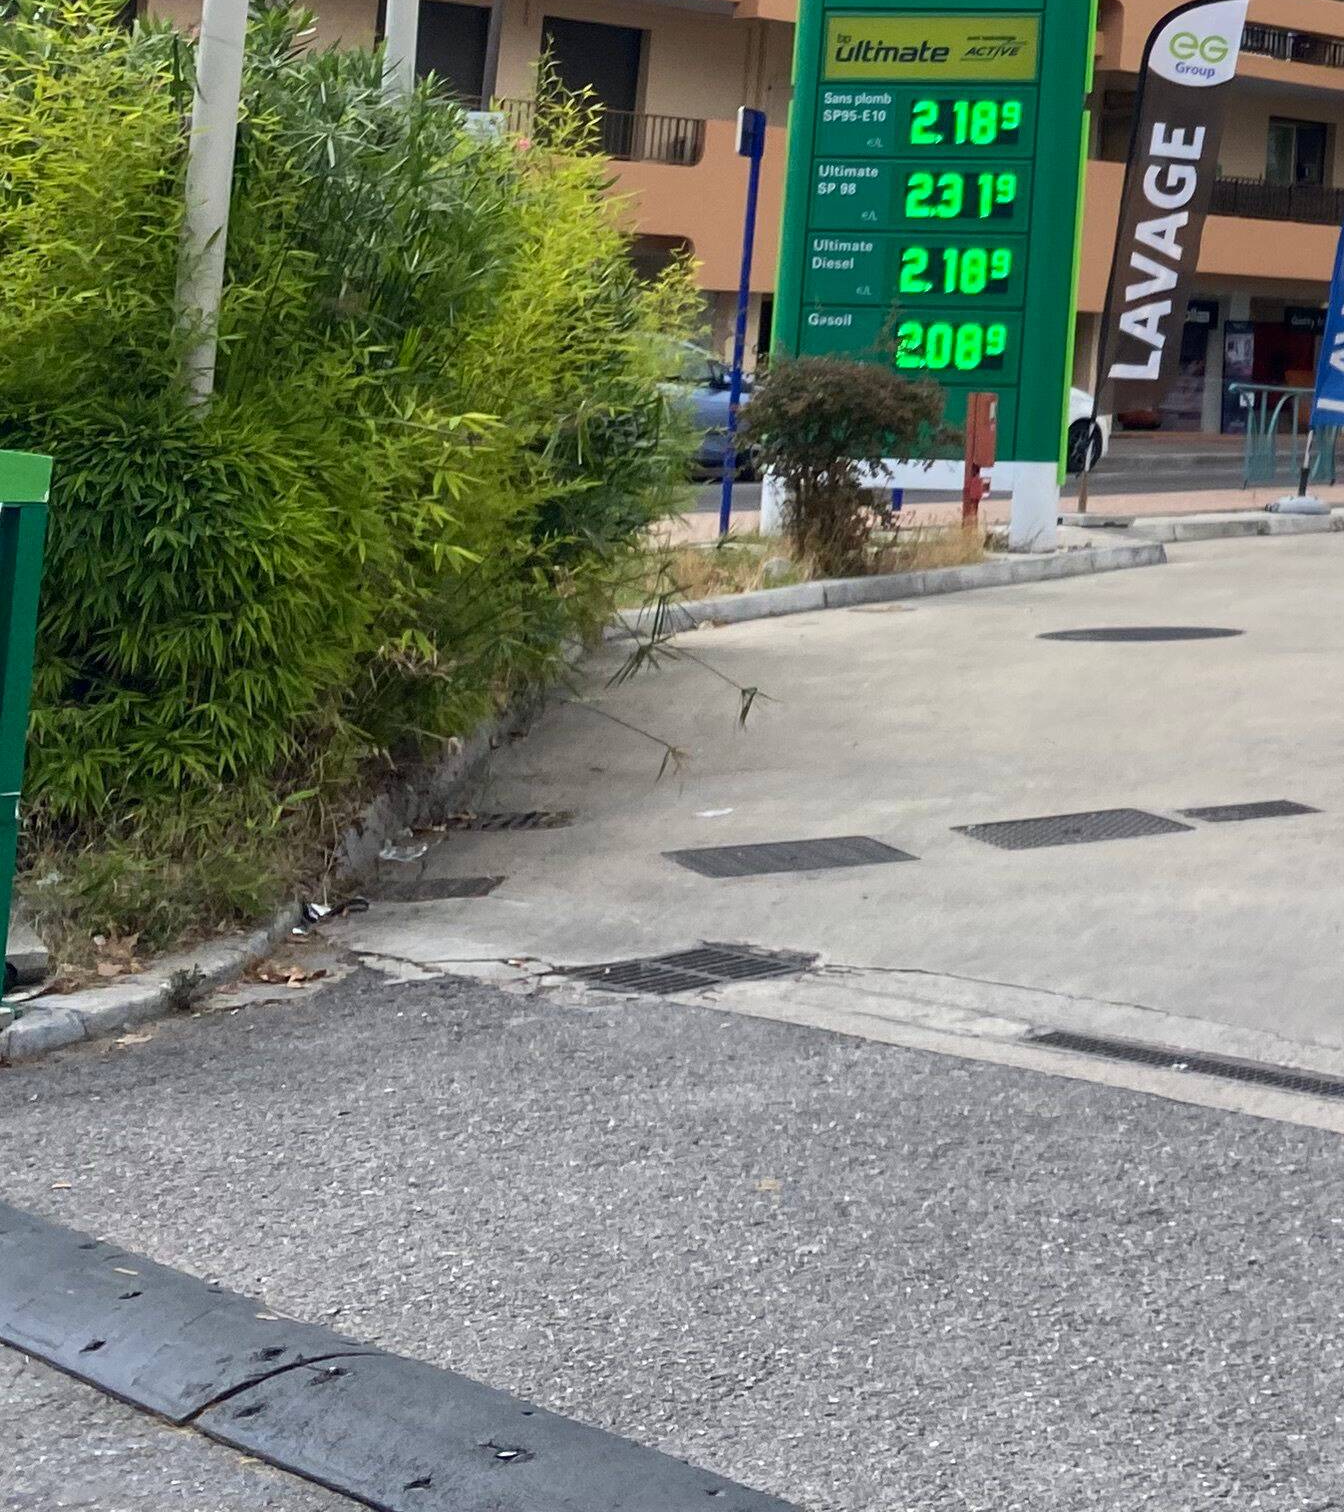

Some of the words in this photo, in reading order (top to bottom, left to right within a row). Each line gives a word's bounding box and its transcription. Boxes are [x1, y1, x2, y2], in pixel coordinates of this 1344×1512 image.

[835, 39, 950, 63] ultimate
[964, 45, 1020, 57] ACTIVE
[1175, 61, 1215, 79] Group
[824, 92, 852, 104] Sans
[853, 92, 892, 107] plomb
[823, 109, 886, 123] SP95-E10
[818, 165, 879, 178] Ultimate
[817, 182, 836, 196] SP
[813, 240, 873, 253] Ultimate
[1108, 121, 1206, 381] LAVAGE
[811, 257, 854, 270] Diesel
[808, 313, 852, 327] Gasoil
